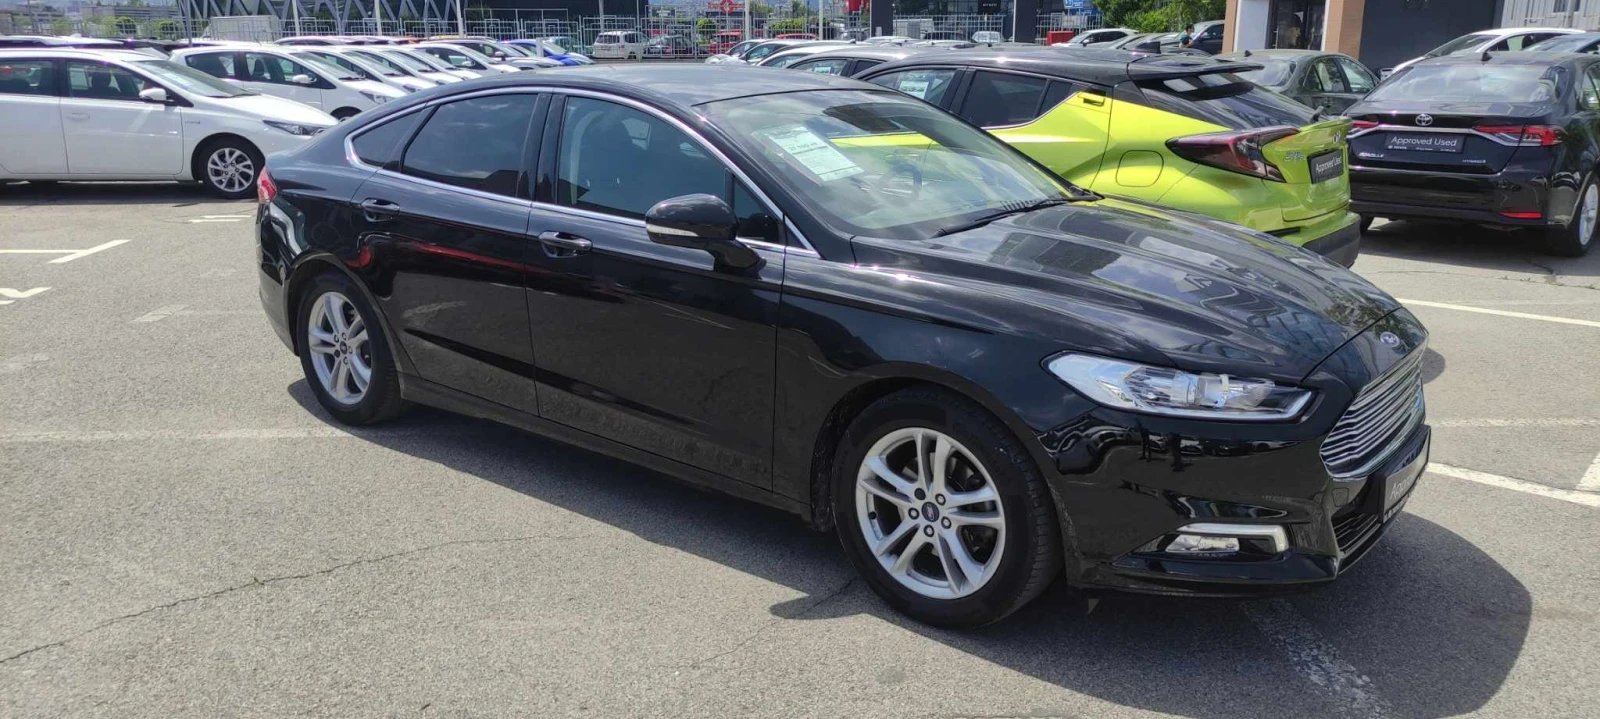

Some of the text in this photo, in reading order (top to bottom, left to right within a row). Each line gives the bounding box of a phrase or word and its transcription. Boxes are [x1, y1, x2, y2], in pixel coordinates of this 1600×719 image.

[1391, 136, 1457, 147] Approved Used
[1315, 157, 1334, 174] Approved
